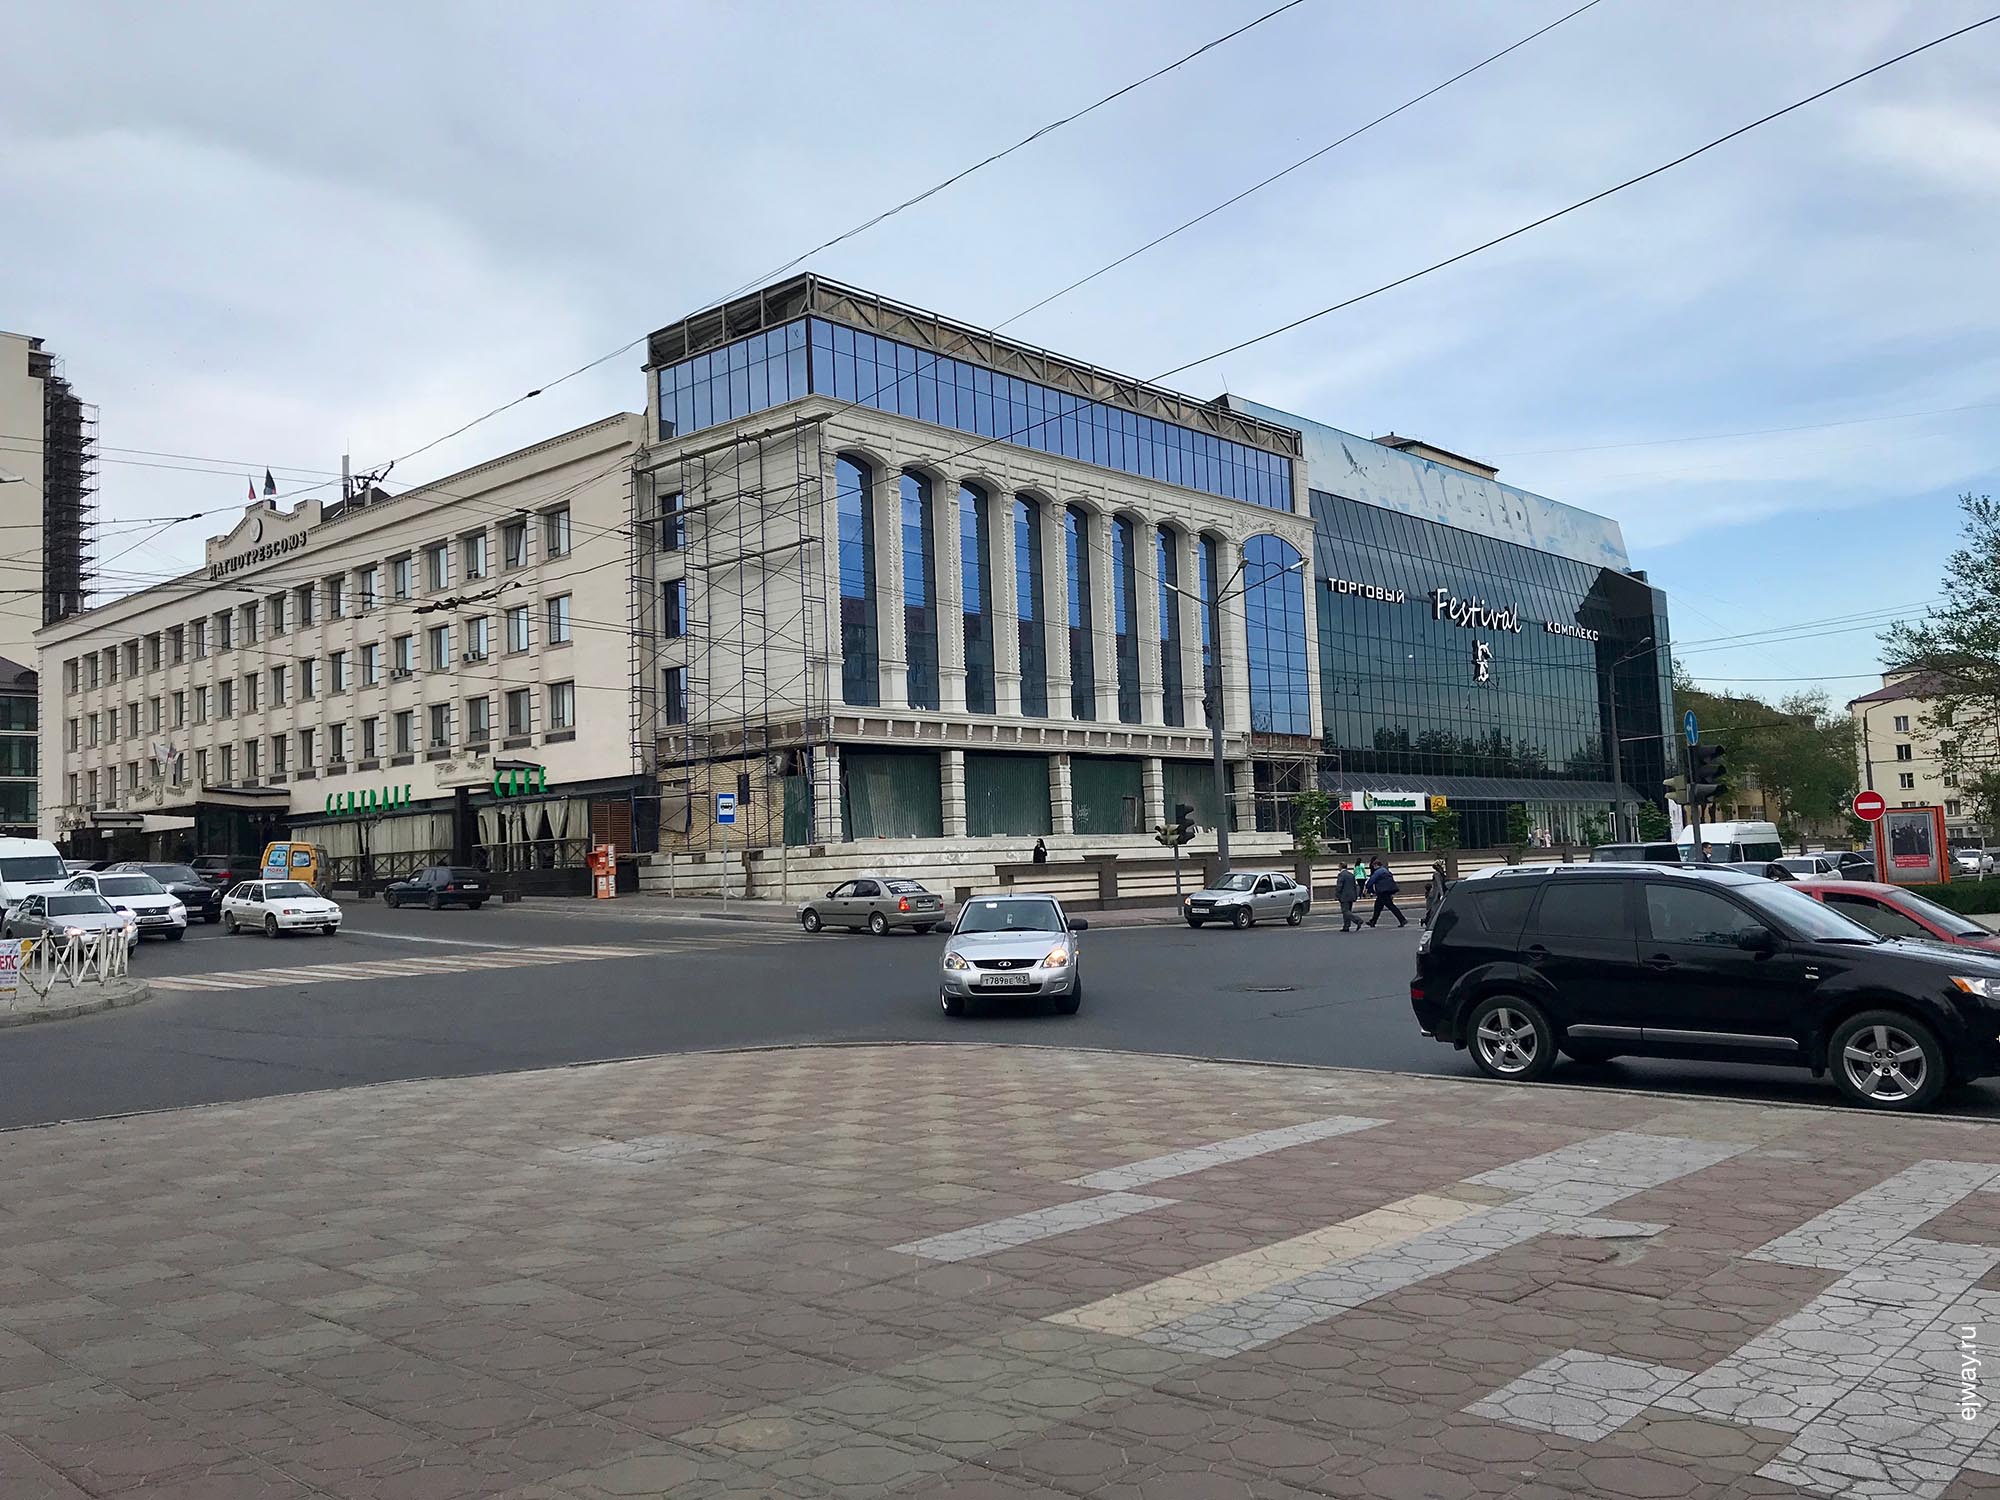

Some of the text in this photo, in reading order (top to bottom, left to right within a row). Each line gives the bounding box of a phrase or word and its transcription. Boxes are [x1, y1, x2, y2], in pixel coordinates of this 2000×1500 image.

[1328, 577, 1405, 604] ТОРГОВЫЙ
[1434, 588, 1523, 634] Festival
[1546, 621, 1599, 641] КОМПЛЕКС
[325, 784, 411, 817] CENTRALE
